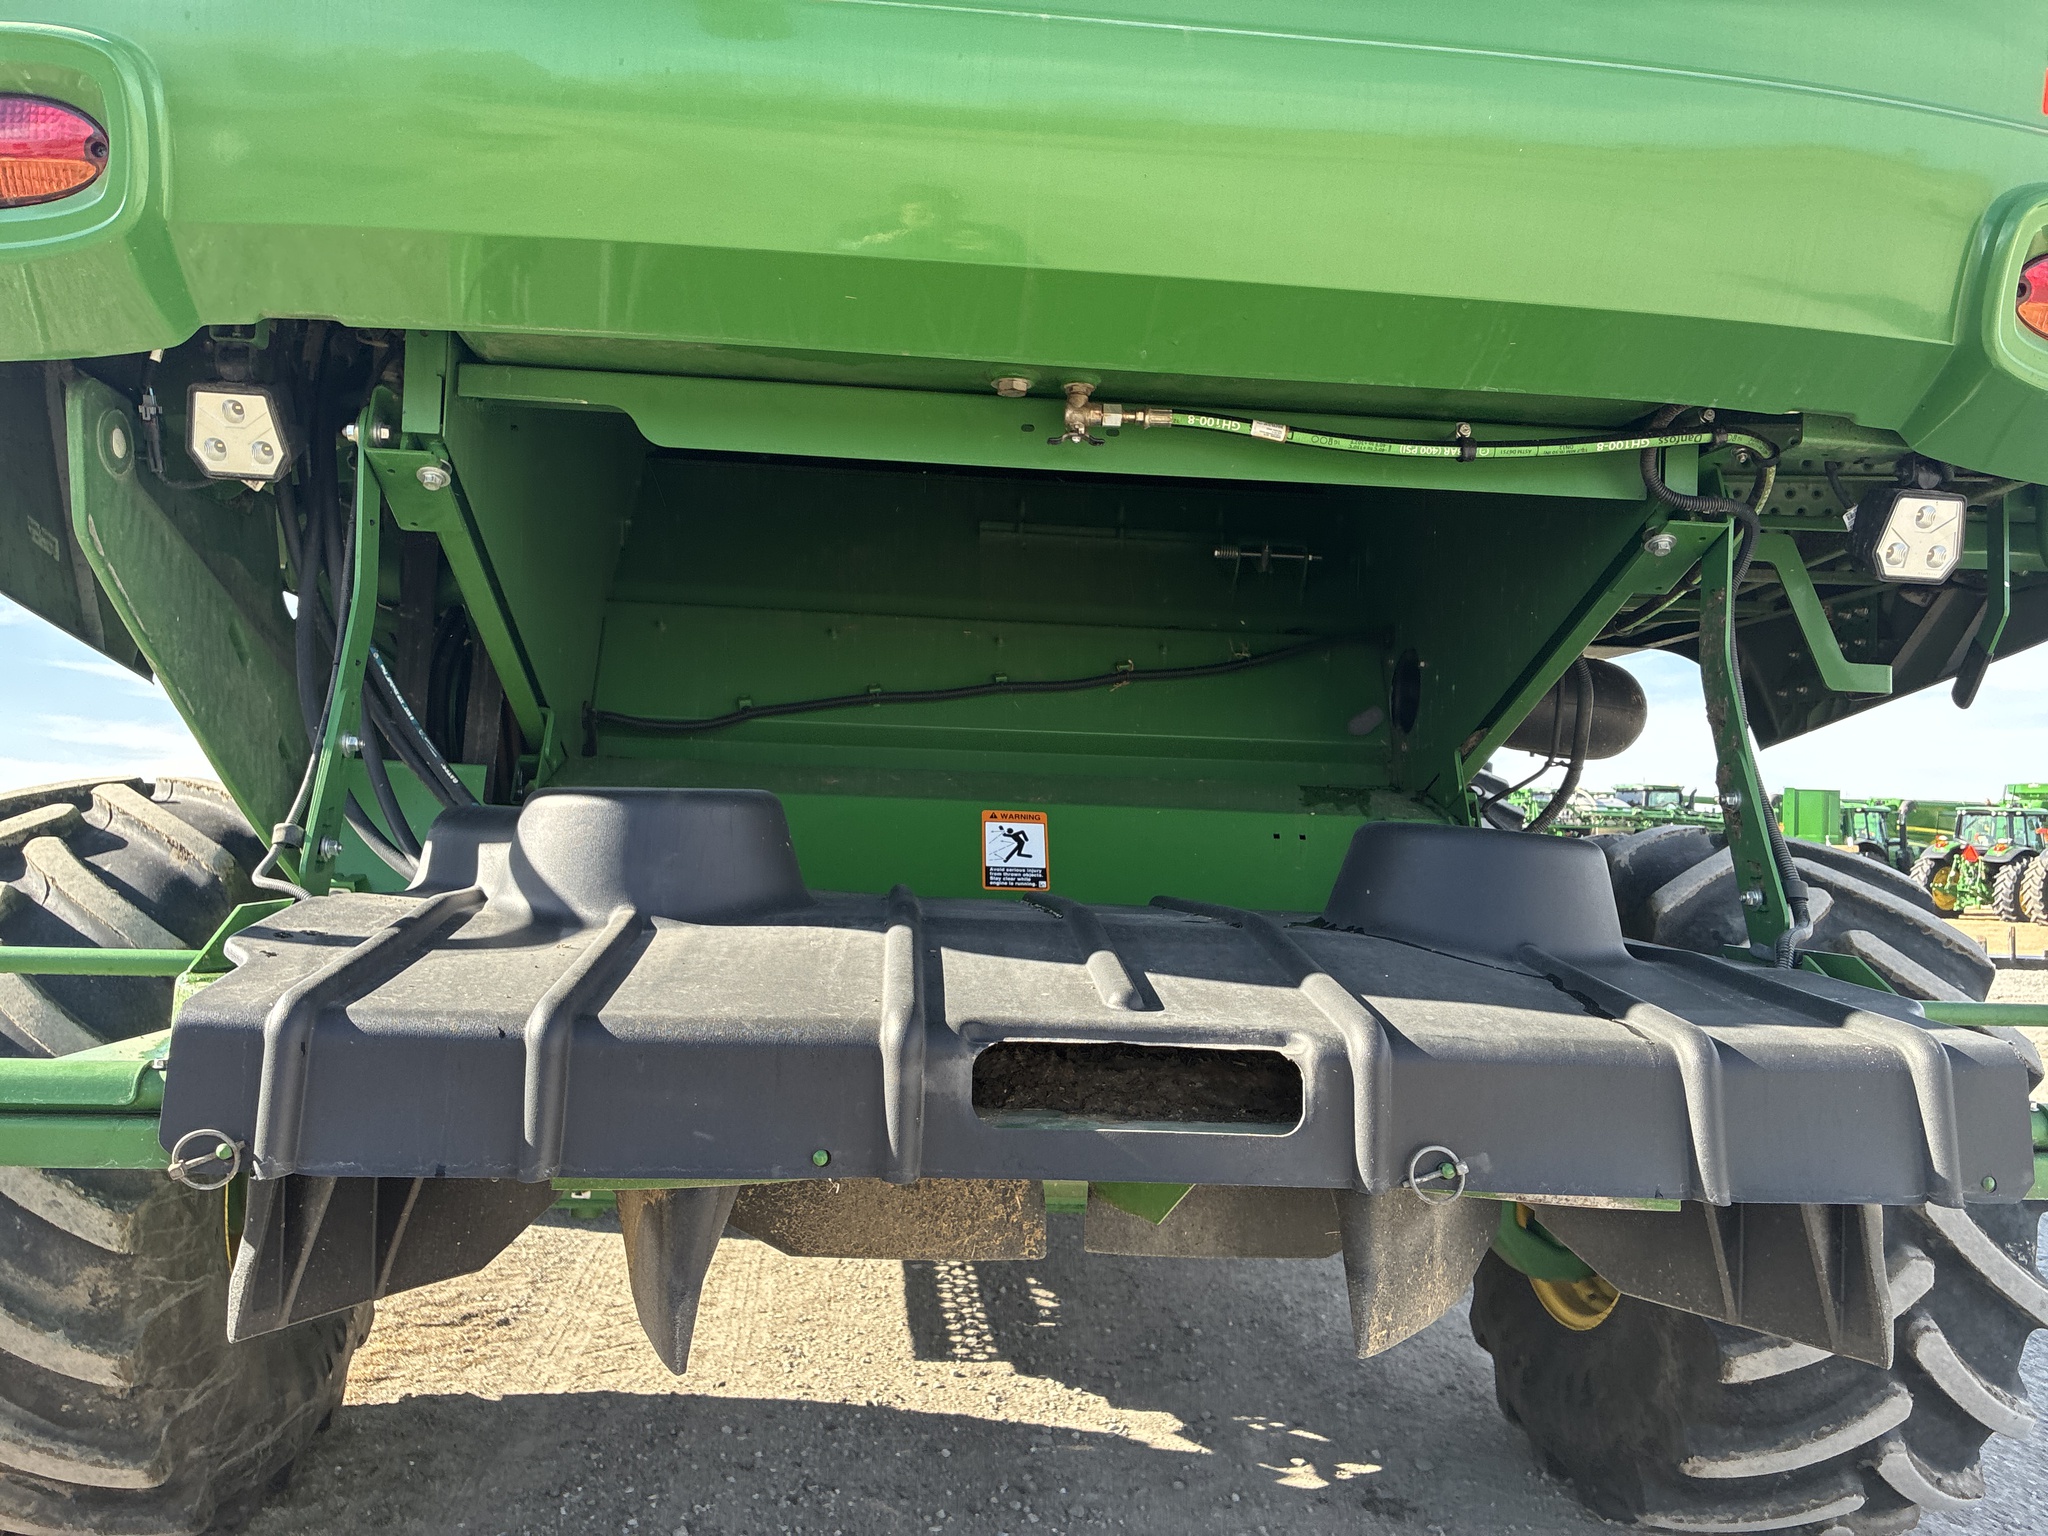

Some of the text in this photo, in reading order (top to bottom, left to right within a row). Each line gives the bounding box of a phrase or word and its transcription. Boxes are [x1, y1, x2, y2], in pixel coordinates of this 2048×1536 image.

[1187, 415, 1241, 431] GH100-8
[1399, 444, 1418, 454] PSI)
[1596, 434, 1703, 451] Danfoss GH100-8
[1420, 445, 1442, 455] (400
